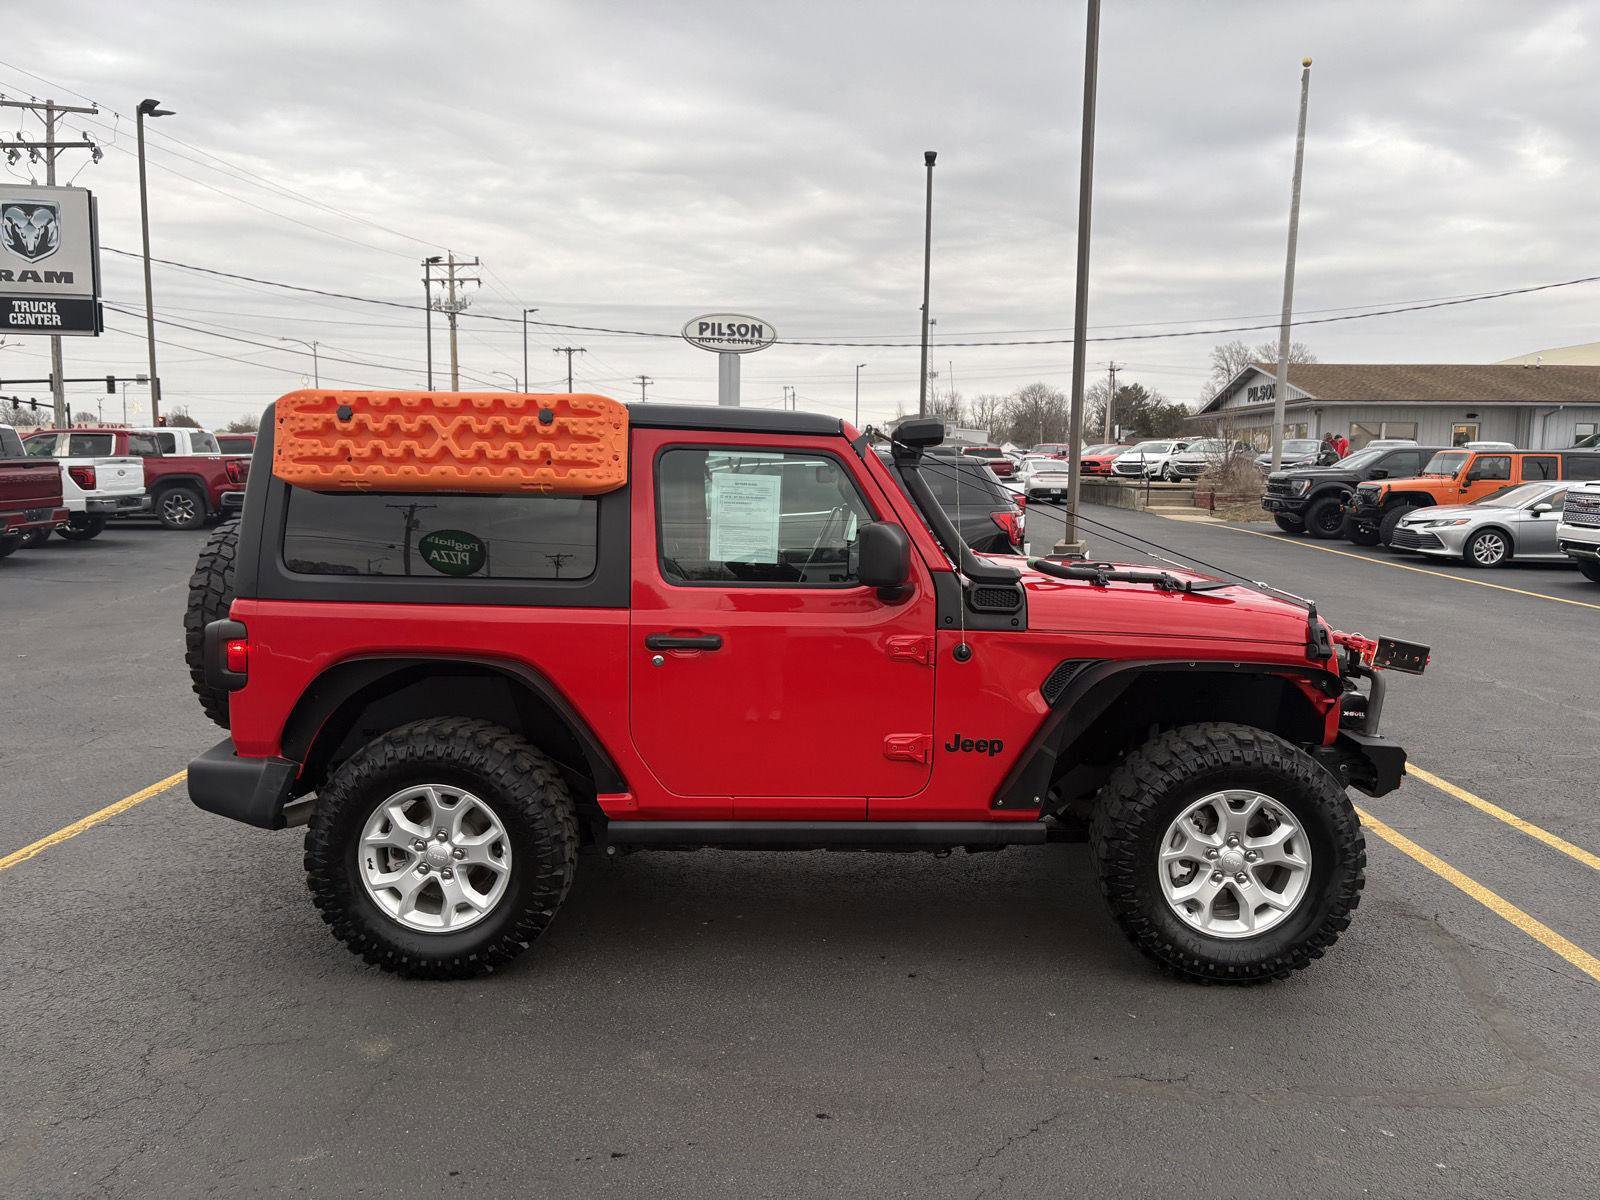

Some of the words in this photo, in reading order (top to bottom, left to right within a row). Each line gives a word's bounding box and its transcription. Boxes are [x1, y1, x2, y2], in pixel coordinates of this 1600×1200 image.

[12, 301, 57, 313] TRUCK
[9, 313, 62, 326] CENTER
[698, 321, 763, 338] PILSON
[945, 733, 1004, 757] Jeep
